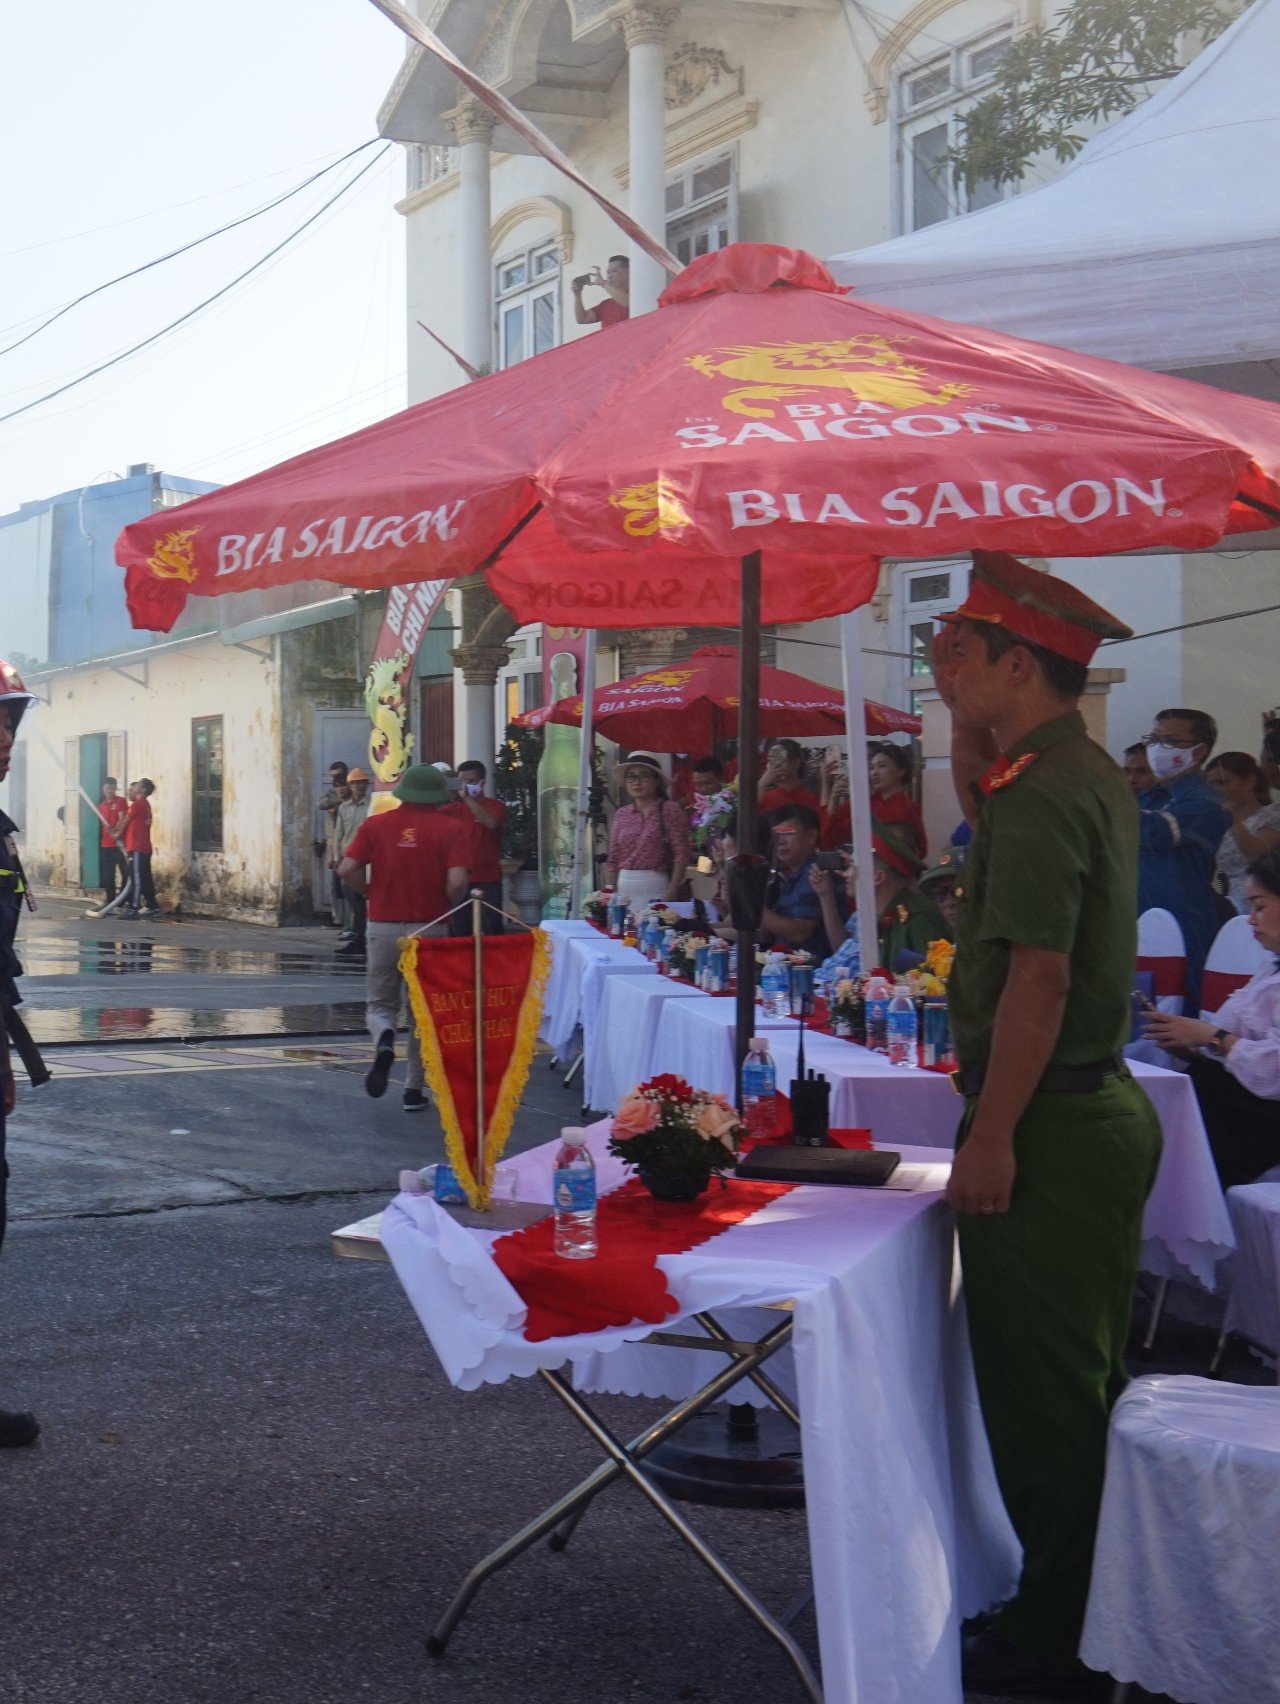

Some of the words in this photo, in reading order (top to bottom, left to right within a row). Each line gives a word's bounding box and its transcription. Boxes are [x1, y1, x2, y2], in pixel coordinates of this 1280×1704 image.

[784, 401, 894, 418] BIA
[675, 412, 1033, 449] SAIGON
[726, 489, 870, 530] BIA
[881, 477, 1166, 528] SAIGON
[215, 526, 286, 577] BIA
[291, 500, 466, 558] SAIGON
[597, 701, 625, 712] BIA
